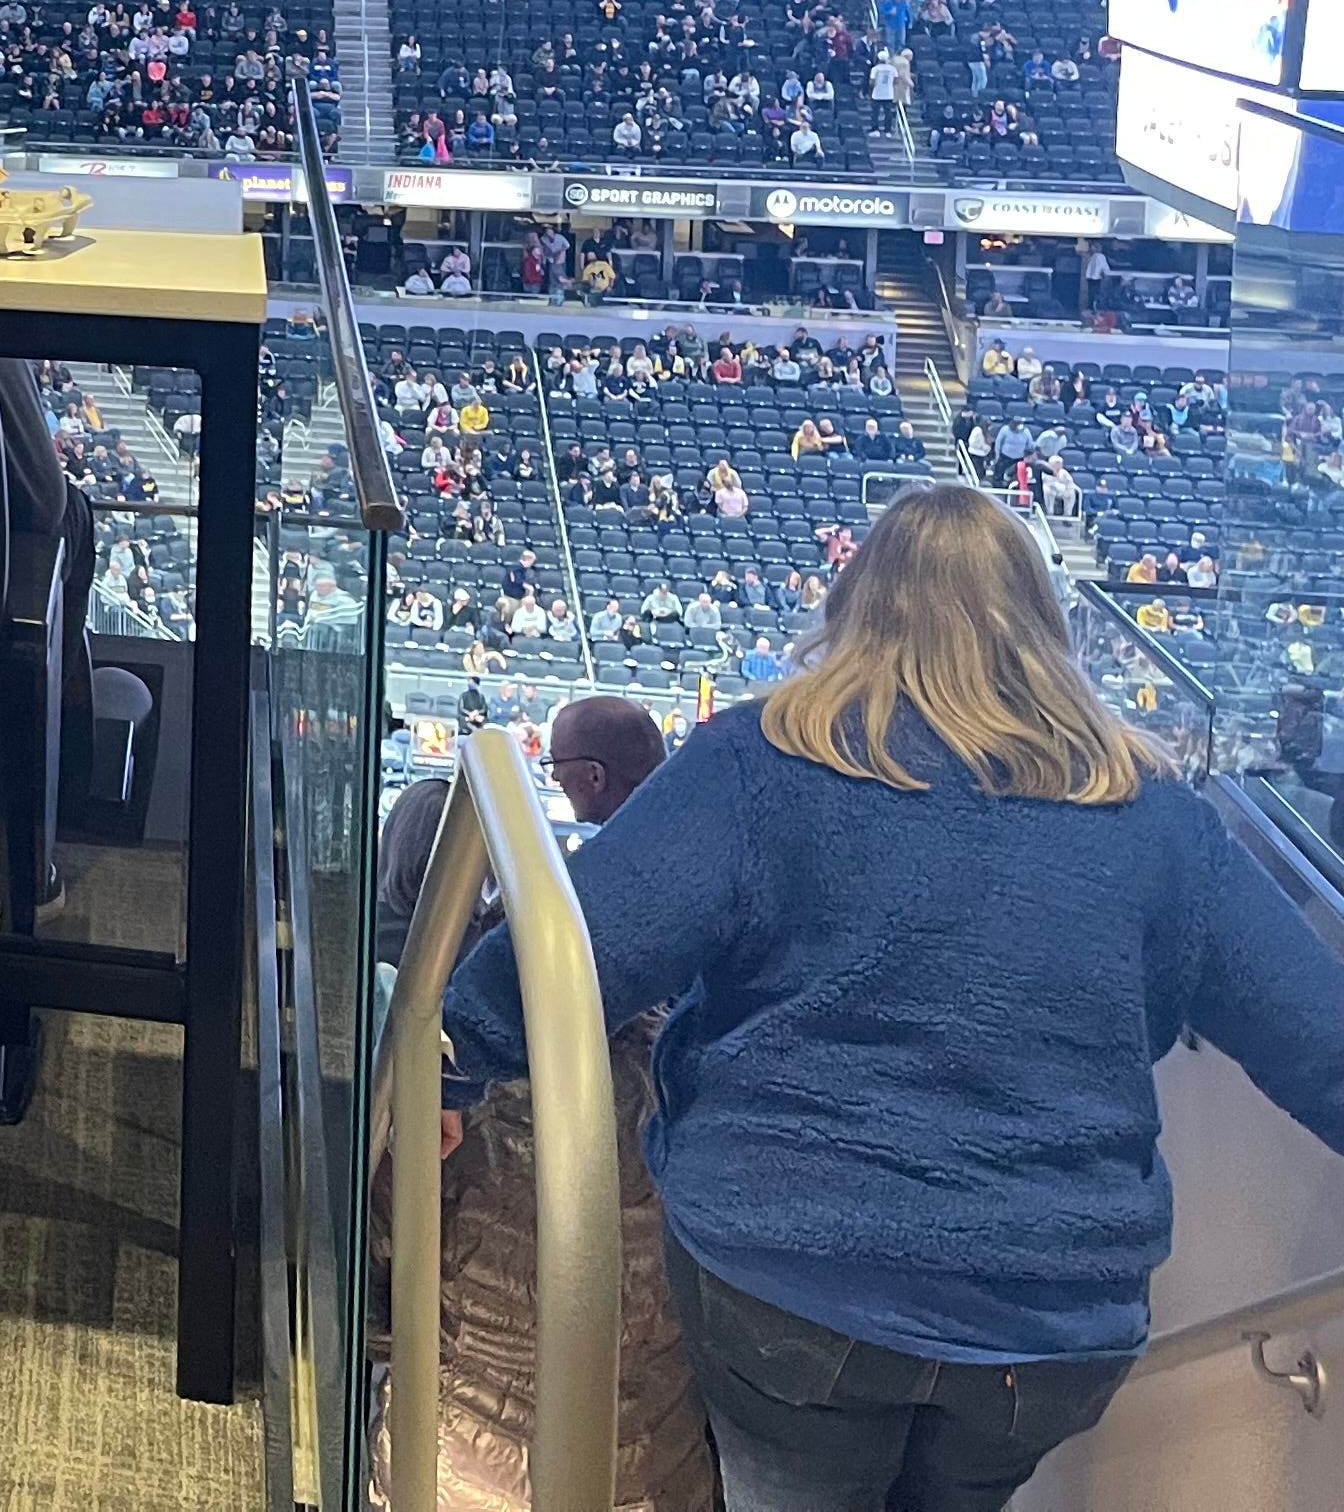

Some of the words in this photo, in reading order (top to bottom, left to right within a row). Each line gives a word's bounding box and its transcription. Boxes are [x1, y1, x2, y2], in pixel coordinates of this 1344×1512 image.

[242, 176, 291, 193] planet
[387, 174, 443, 189] INDIANA
[590, 187, 639, 204] SPORT
[641, 190, 715, 207] GRAPHICS
[798, 195, 895, 216] motorola
[992, 202, 1039, 214] COAST
[1054, 205, 1100, 217] COAST
